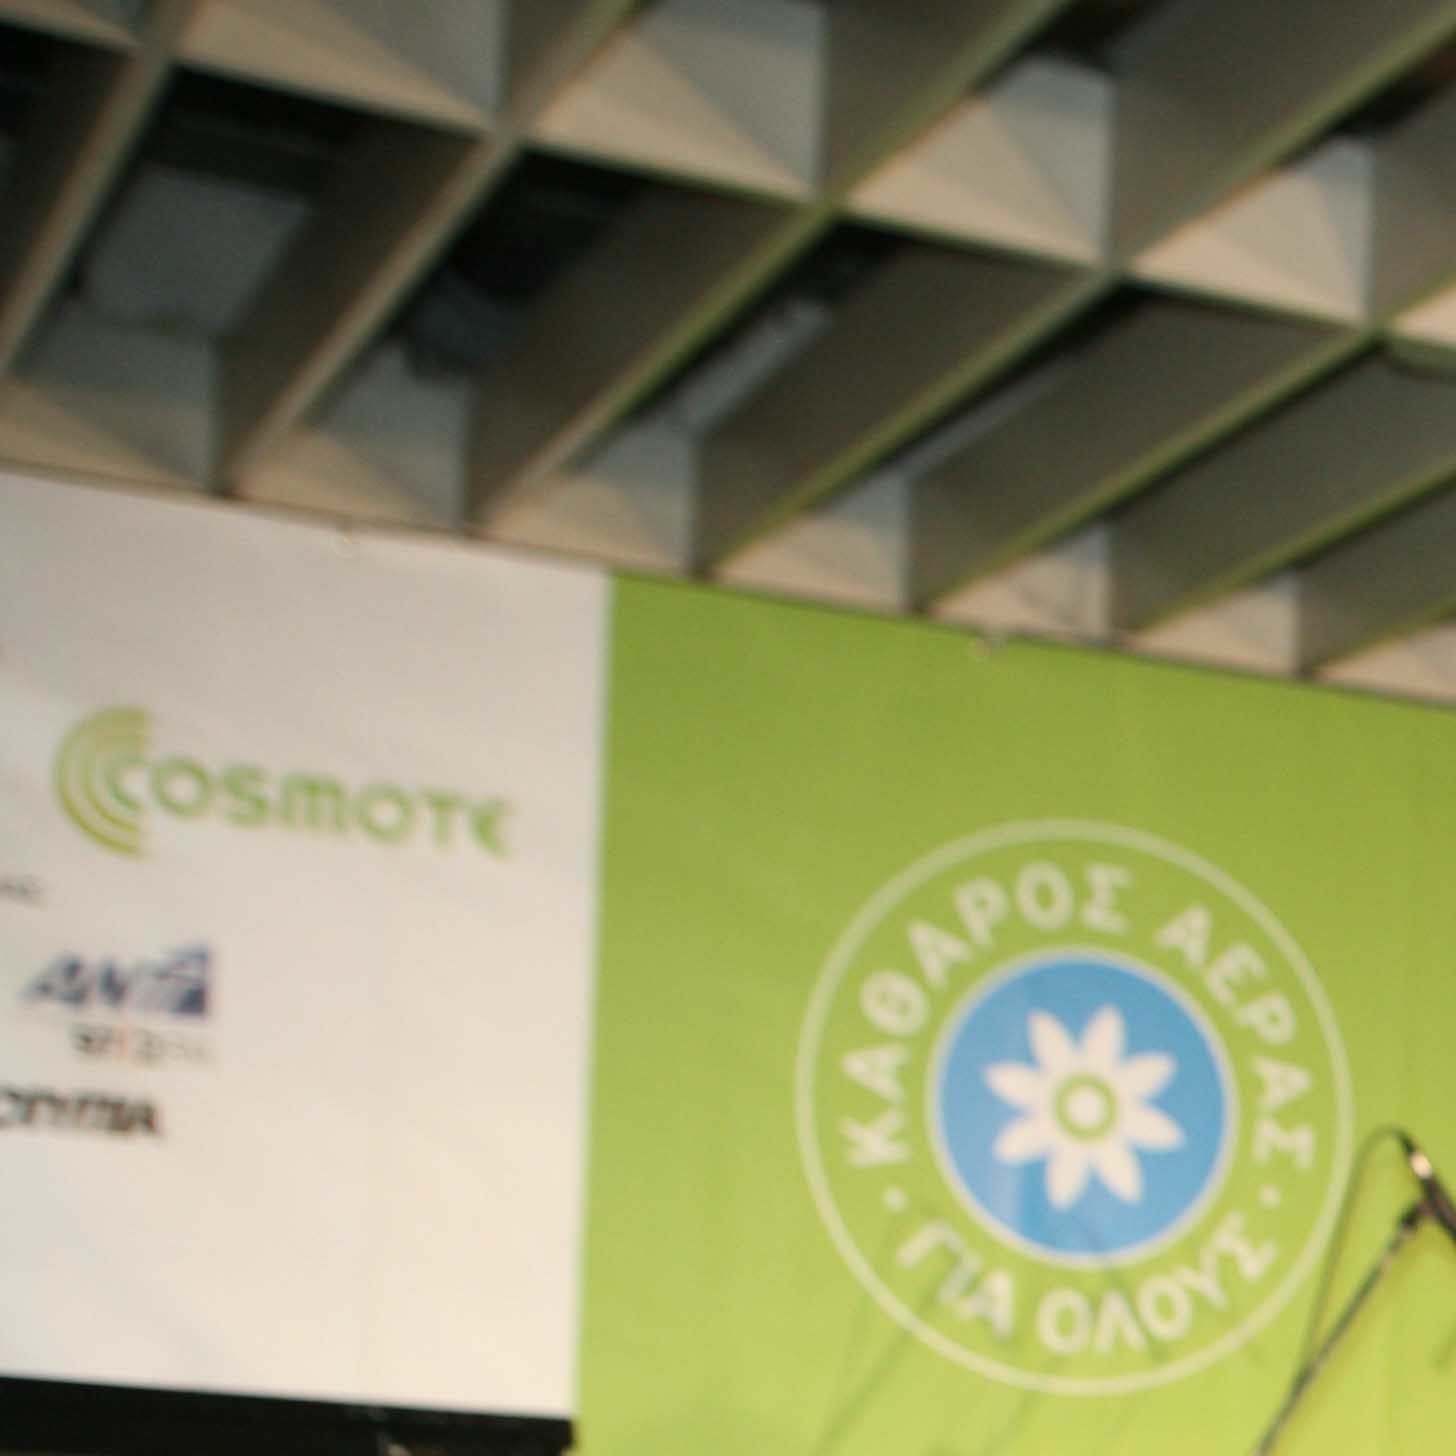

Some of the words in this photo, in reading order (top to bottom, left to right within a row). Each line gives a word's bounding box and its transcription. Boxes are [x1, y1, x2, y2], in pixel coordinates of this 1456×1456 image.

[840, 861, 1134, 1168] ΚΑΘΑΡΟΣ
[1154, 904, 1316, 1171] ΑΕΡΑΣ
[897, 1220, 1016, 1341] ΓΙΑ
[1035, 1211, 1278, 1354] ΟΛΟΥΣ
